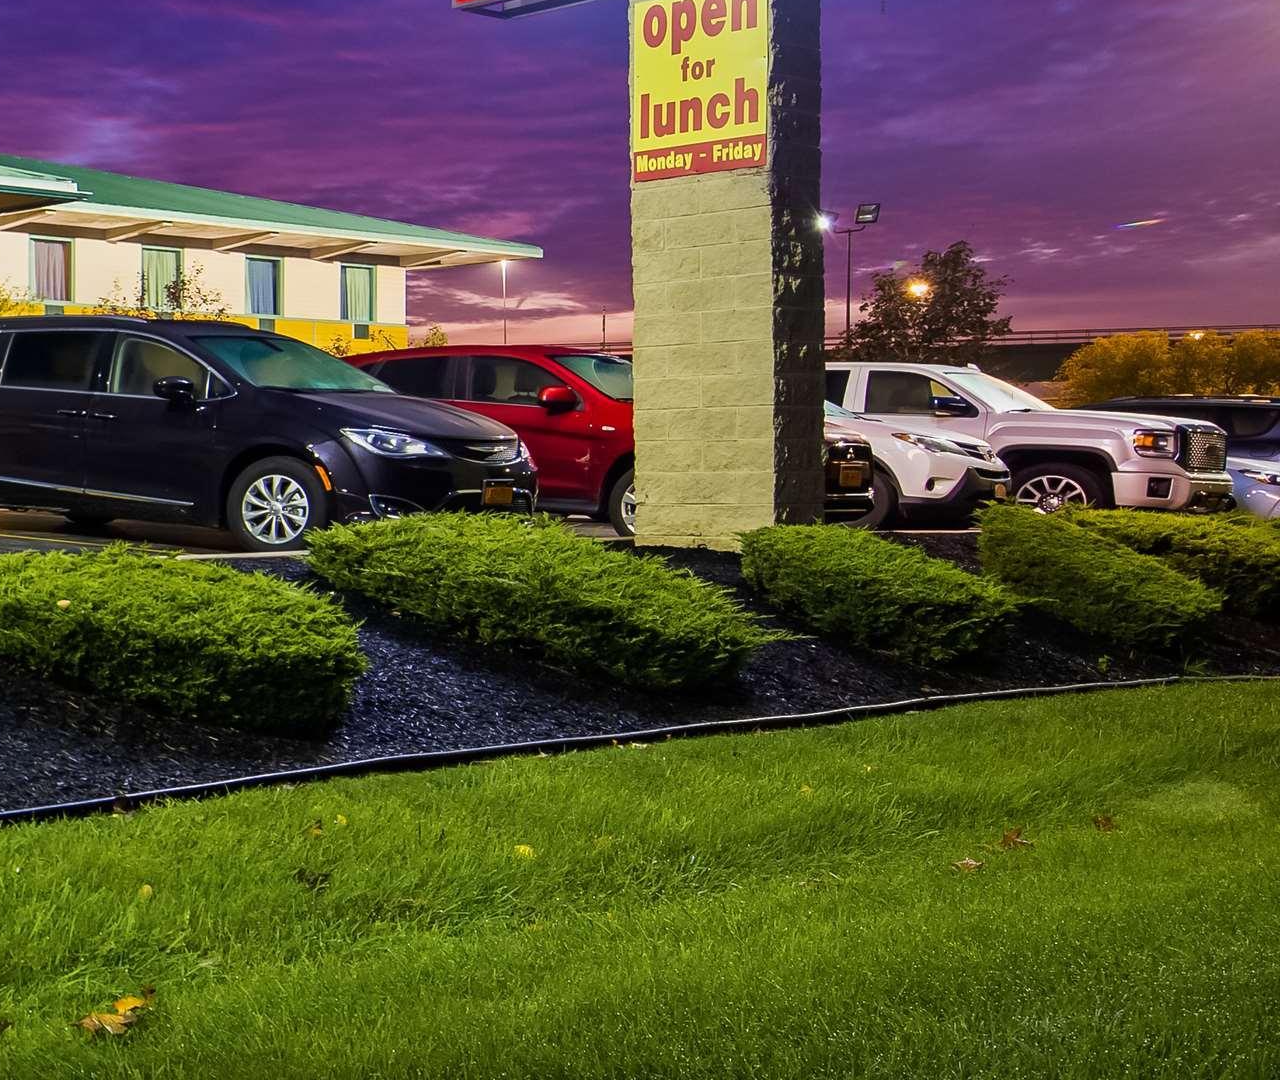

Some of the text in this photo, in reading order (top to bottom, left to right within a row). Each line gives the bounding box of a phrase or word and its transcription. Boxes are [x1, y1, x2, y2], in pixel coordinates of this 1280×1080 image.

[680, 57, 715, 81] for
[639, 78, 759, 139] lunch
[636, 150, 693, 172] Monday
[712, 143, 762, 162] Friday
